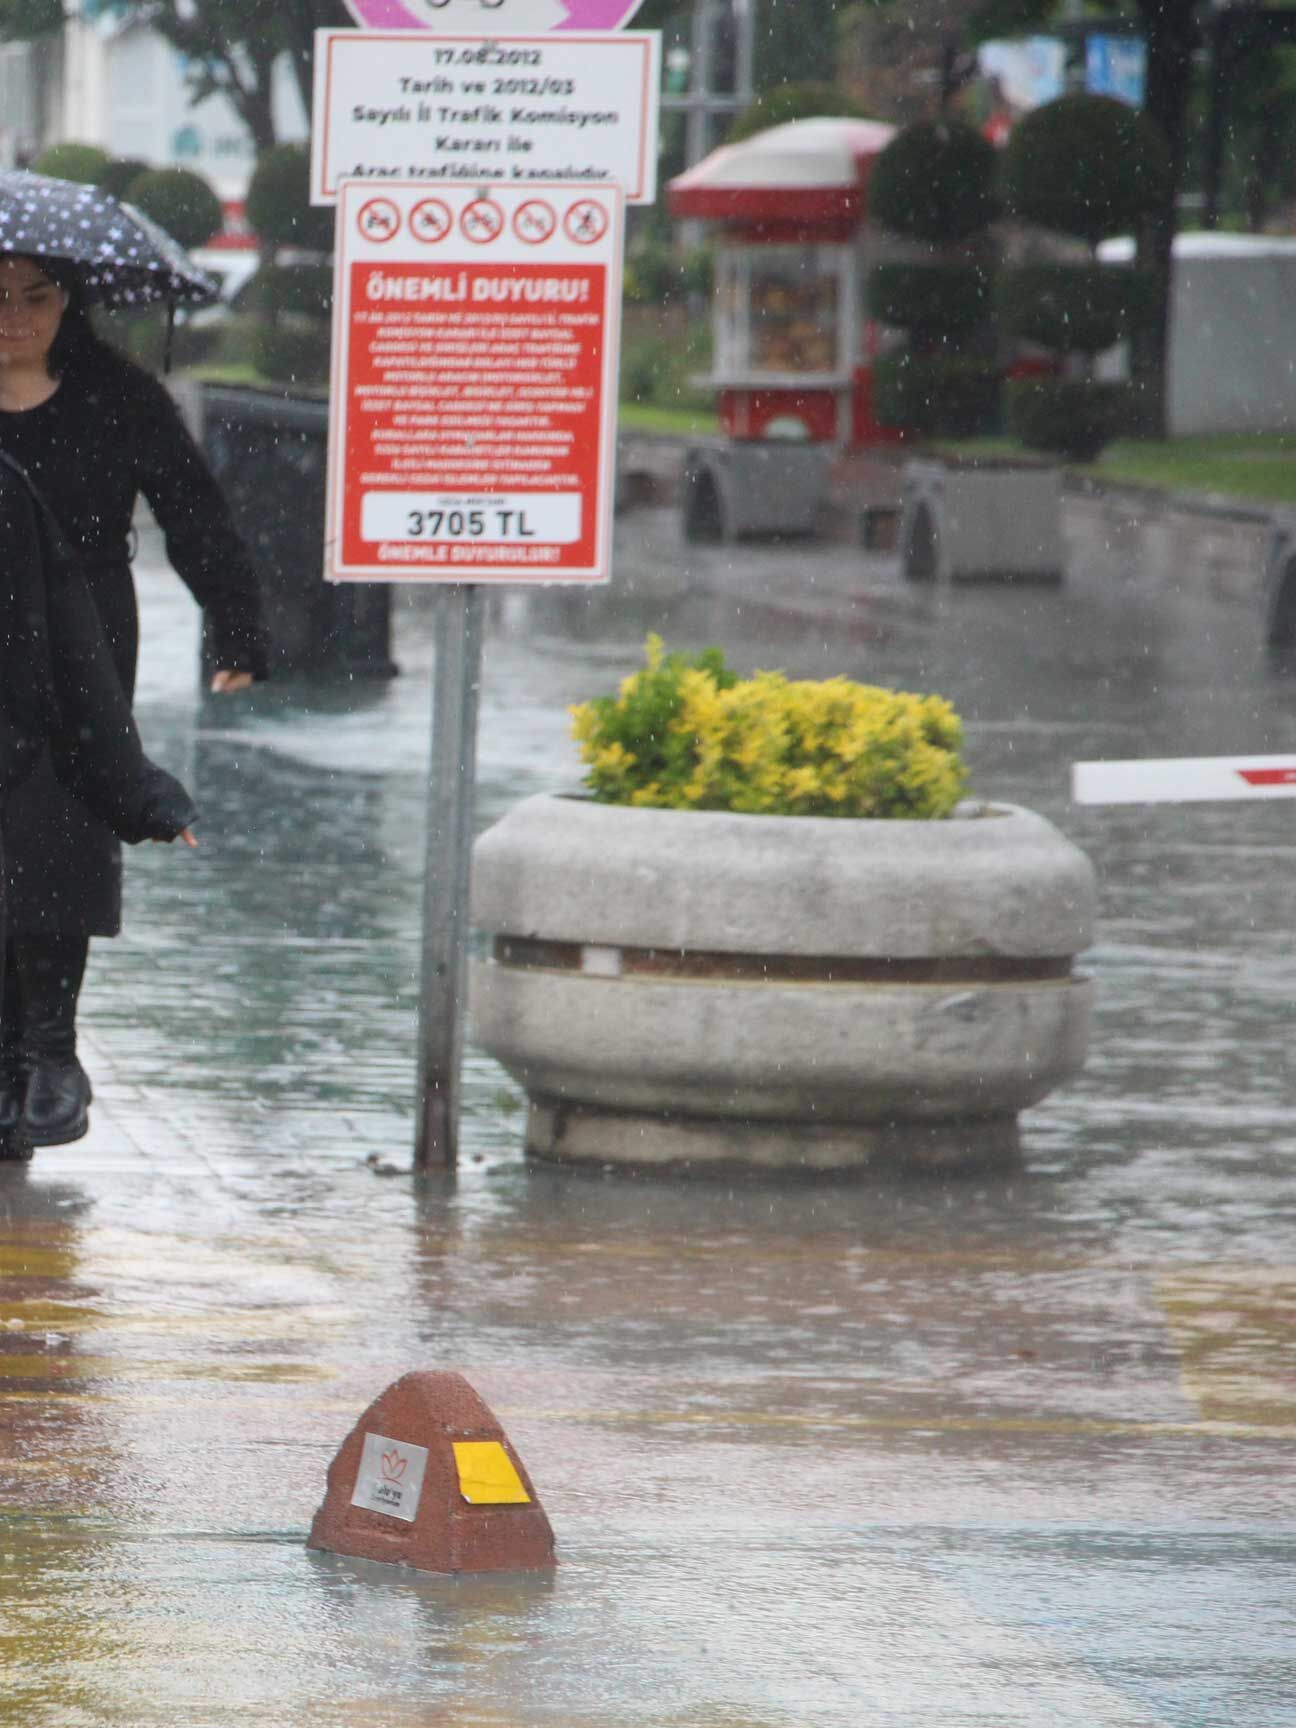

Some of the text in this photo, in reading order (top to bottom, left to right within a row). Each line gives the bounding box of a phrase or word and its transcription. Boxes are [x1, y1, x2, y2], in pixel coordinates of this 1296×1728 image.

[398, 75, 453, 94] Tarih
[462, 80, 485, 94] ve
[437, 103, 502, 123] Trafik
[510, 105, 619, 129] Komisyon
[366, 271, 590, 303] ÖNEMLİ DUYURU!
[407, 511, 534, 536] 3705 TL
